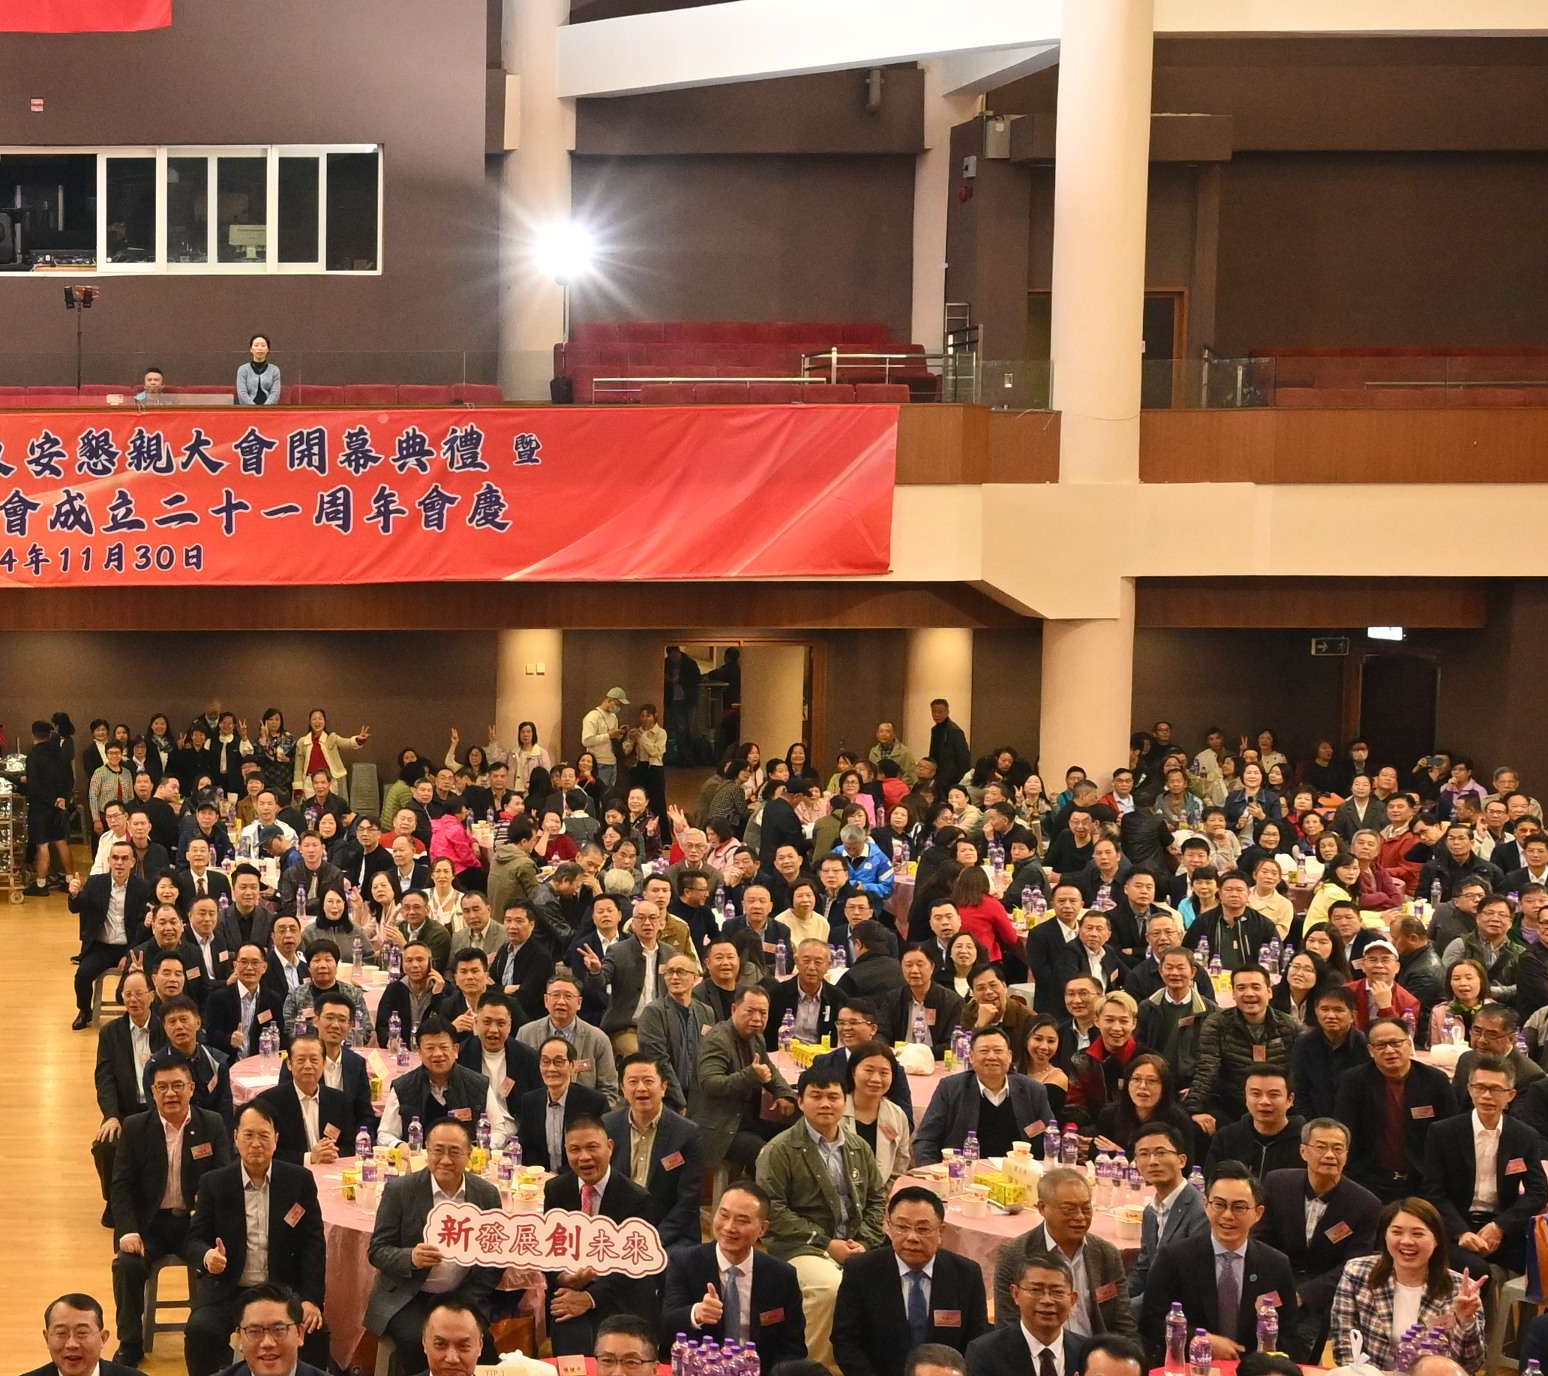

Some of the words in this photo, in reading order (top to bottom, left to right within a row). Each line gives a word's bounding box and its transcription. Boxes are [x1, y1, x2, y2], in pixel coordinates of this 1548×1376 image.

[437, 1215, 654, 1265] 新發展創未來
